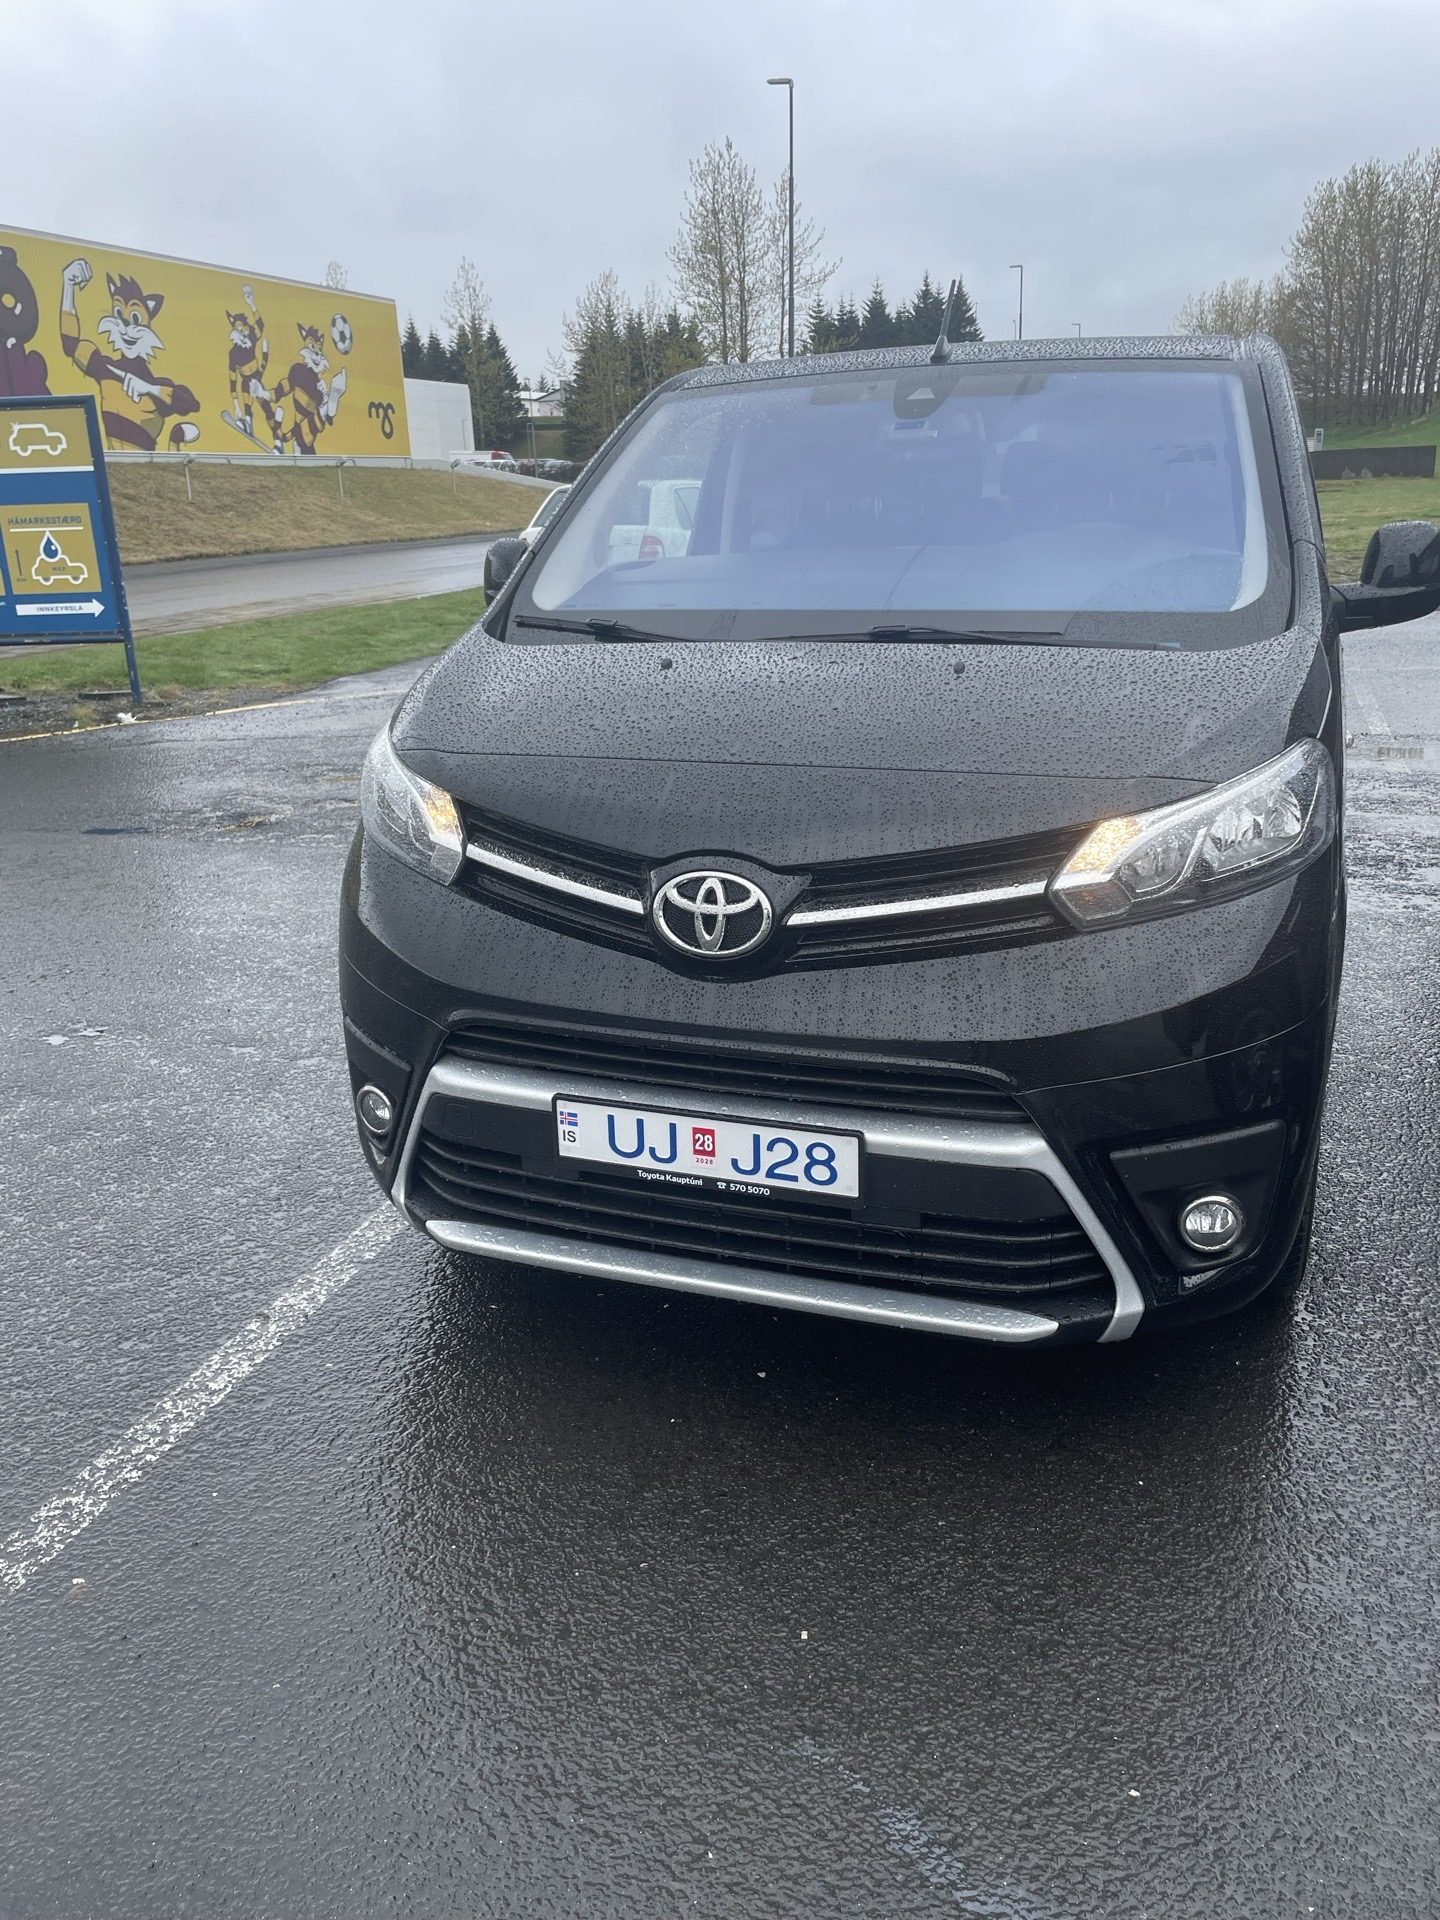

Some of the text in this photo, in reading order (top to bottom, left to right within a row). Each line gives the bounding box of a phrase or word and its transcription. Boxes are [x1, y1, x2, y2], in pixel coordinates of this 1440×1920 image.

[562, 1129, 577, 1143] IS
[694, 1133, 714, 1152] 28
[607, 1113, 839, 1187] UJ J28
[695, 1157, 714, 1165] 2028
[636, 1169, 703, 1186] Toyota Kauptúni
[729, 1183, 771, 1196] 570 5070
